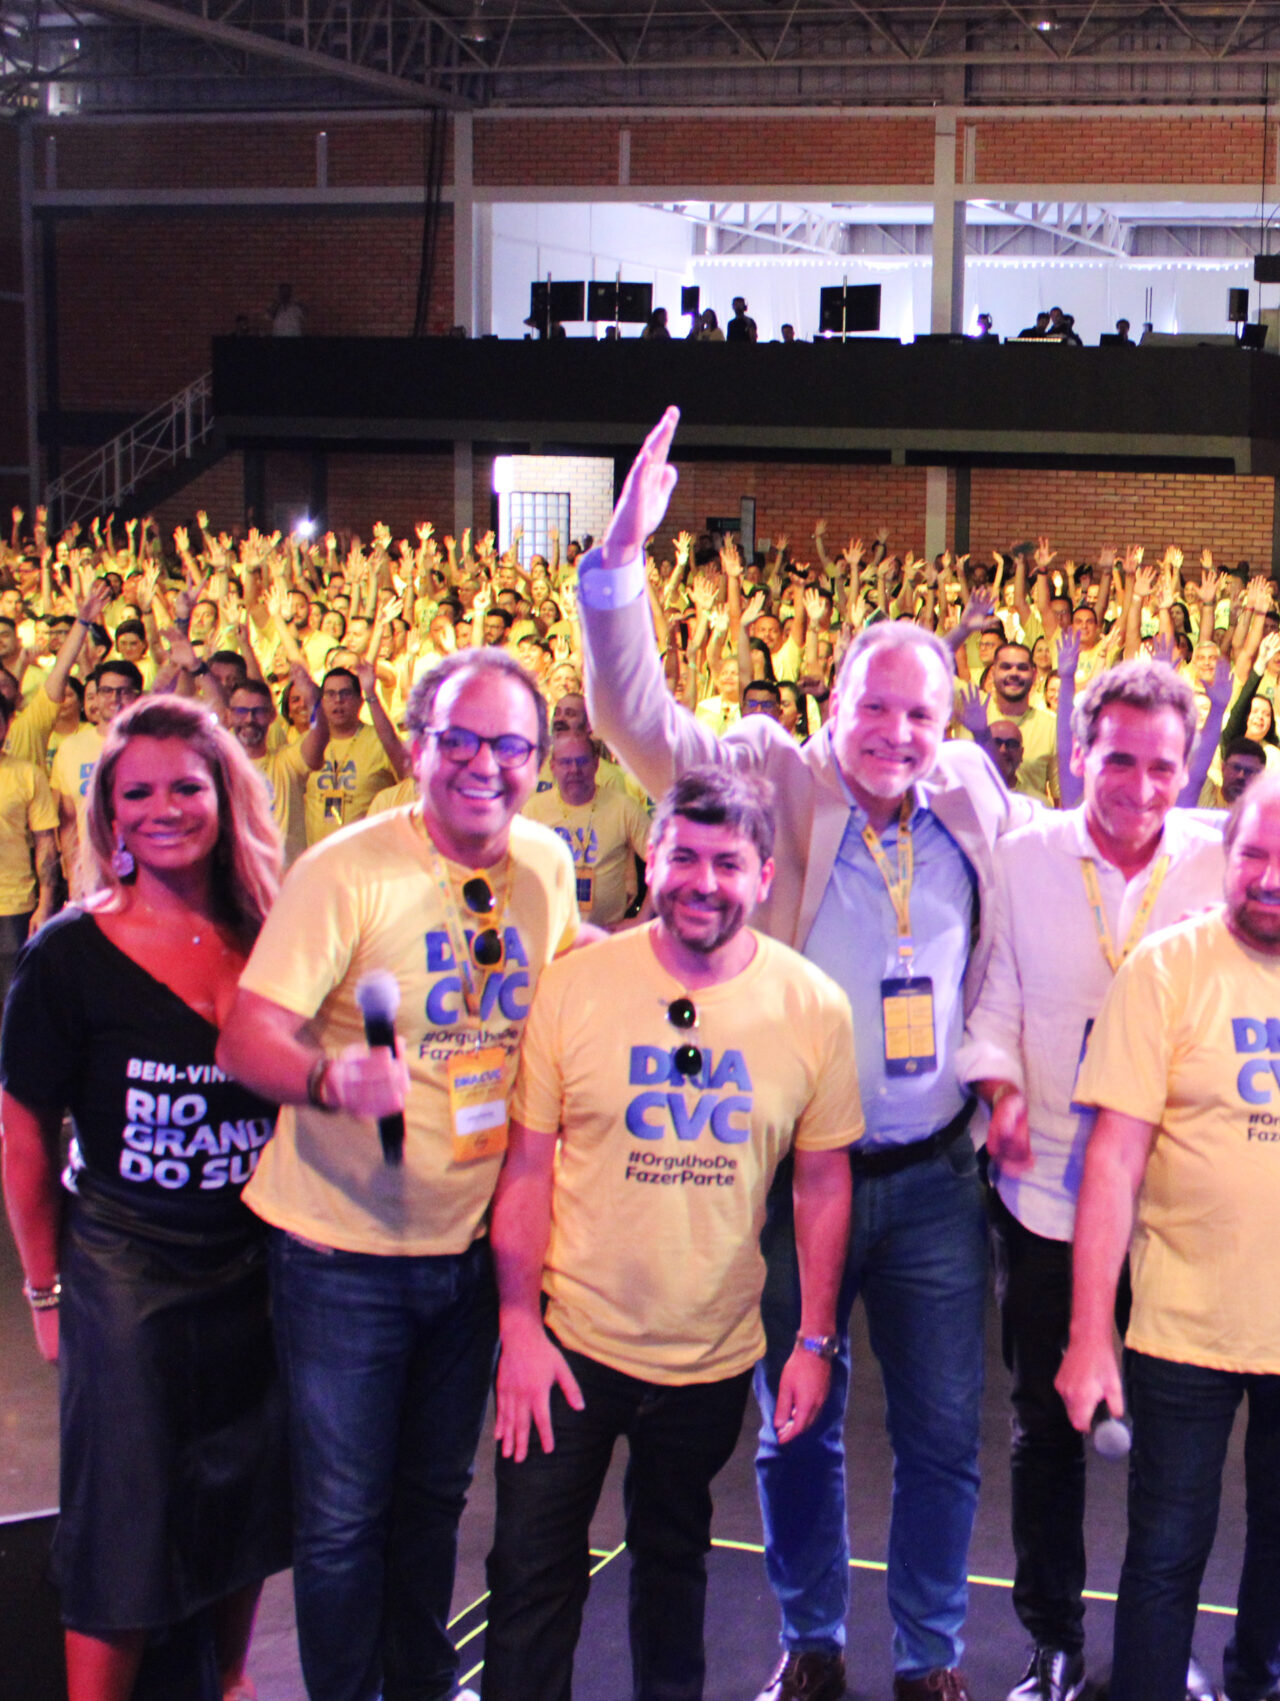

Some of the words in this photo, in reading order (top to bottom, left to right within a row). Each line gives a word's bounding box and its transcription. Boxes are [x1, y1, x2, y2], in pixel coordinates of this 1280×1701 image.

[126, 1057, 234, 1084] BEM-VIN
[125, 1088, 208, 1127] RIO
[625, 1091, 753, 1144] CVC
[122, 1117, 275, 1158] GRAND
[120, 1148, 191, 1190] DO
[200, 1150, 259, 1190] SU
[625, 1165, 736, 1186] FazerParte
[628, 1151, 738, 1172] #OrgulhoDe
